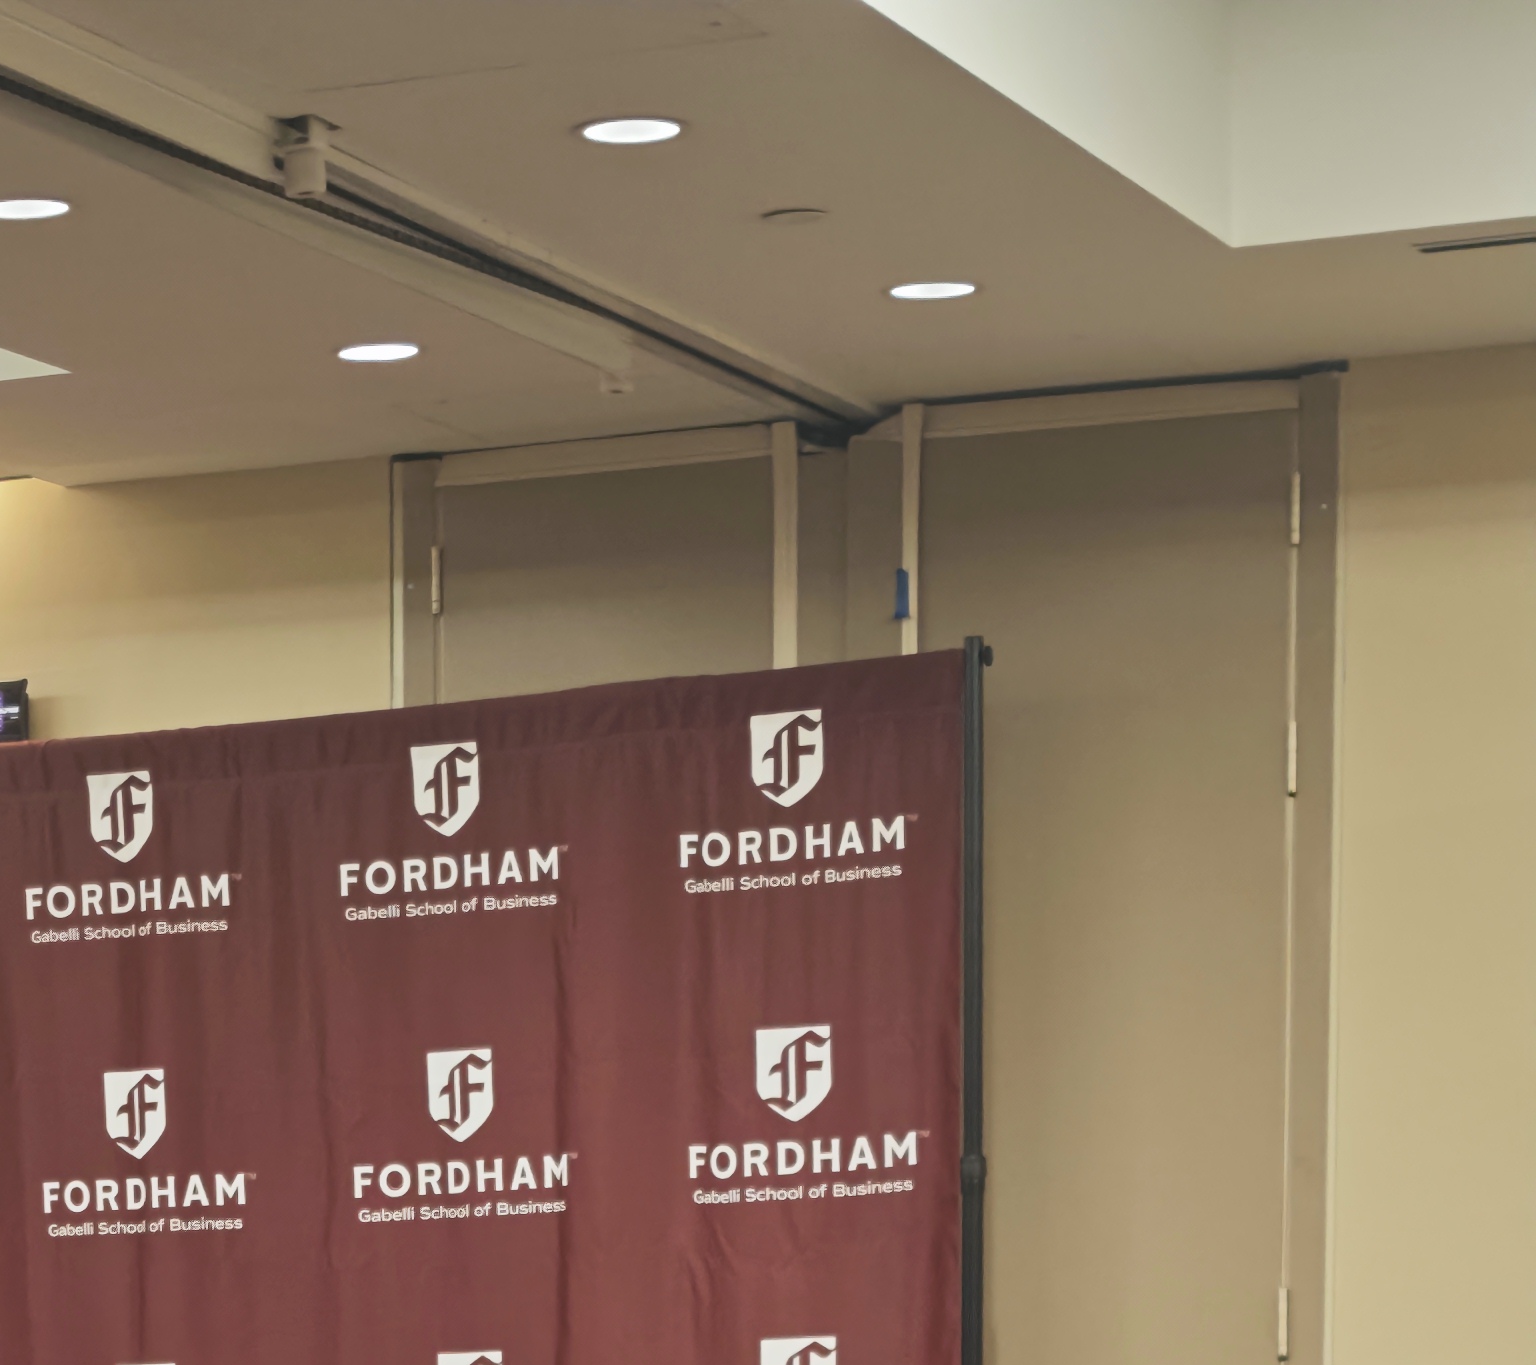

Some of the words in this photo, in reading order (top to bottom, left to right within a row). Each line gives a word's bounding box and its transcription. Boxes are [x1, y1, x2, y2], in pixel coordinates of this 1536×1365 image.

[679, 816, 906, 868] FORDHAM
[340, 847, 559, 897] FORDHAM
[684, 876, 735, 894] Gabelli
[739, 872, 797, 890] School
[801, 868, 821, 885] of
[825, 864, 903, 883] Business
[25, 874, 230, 920] FORDHAM
[345, 903, 401, 921] Gabelli
[405, 899, 458, 917] School
[461, 896, 479, 913] of
[483, 892, 559, 910] Business
[31, 926, 80, 944] Gabelli
[83, 924, 136, 940] School
[138, 920, 153, 936] of
[155, 919, 229, 936] Business
[688, 1131, 918, 1179] FORDHAM
[42, 1173, 246, 1213] FORDHAM
[353, 1154, 569, 1198] FORDHAM
[693, 1187, 742, 1204] Gabelli
[745, 1184, 805, 1202] School
[808, 1182, 829, 1199] of
[832, 1178, 915, 1198] Business
[48, 1221, 95, 1237] Gabelli
[98, 1220, 147, 1235] School
[149, 1217, 166, 1233] of
[169, 1216, 244, 1232] Business
[358, 1206, 415, 1222] Gabelli
[419, 1203, 470, 1220] School
[473, 1201, 493, 1218] of
[495, 1199, 567, 1216] Business
